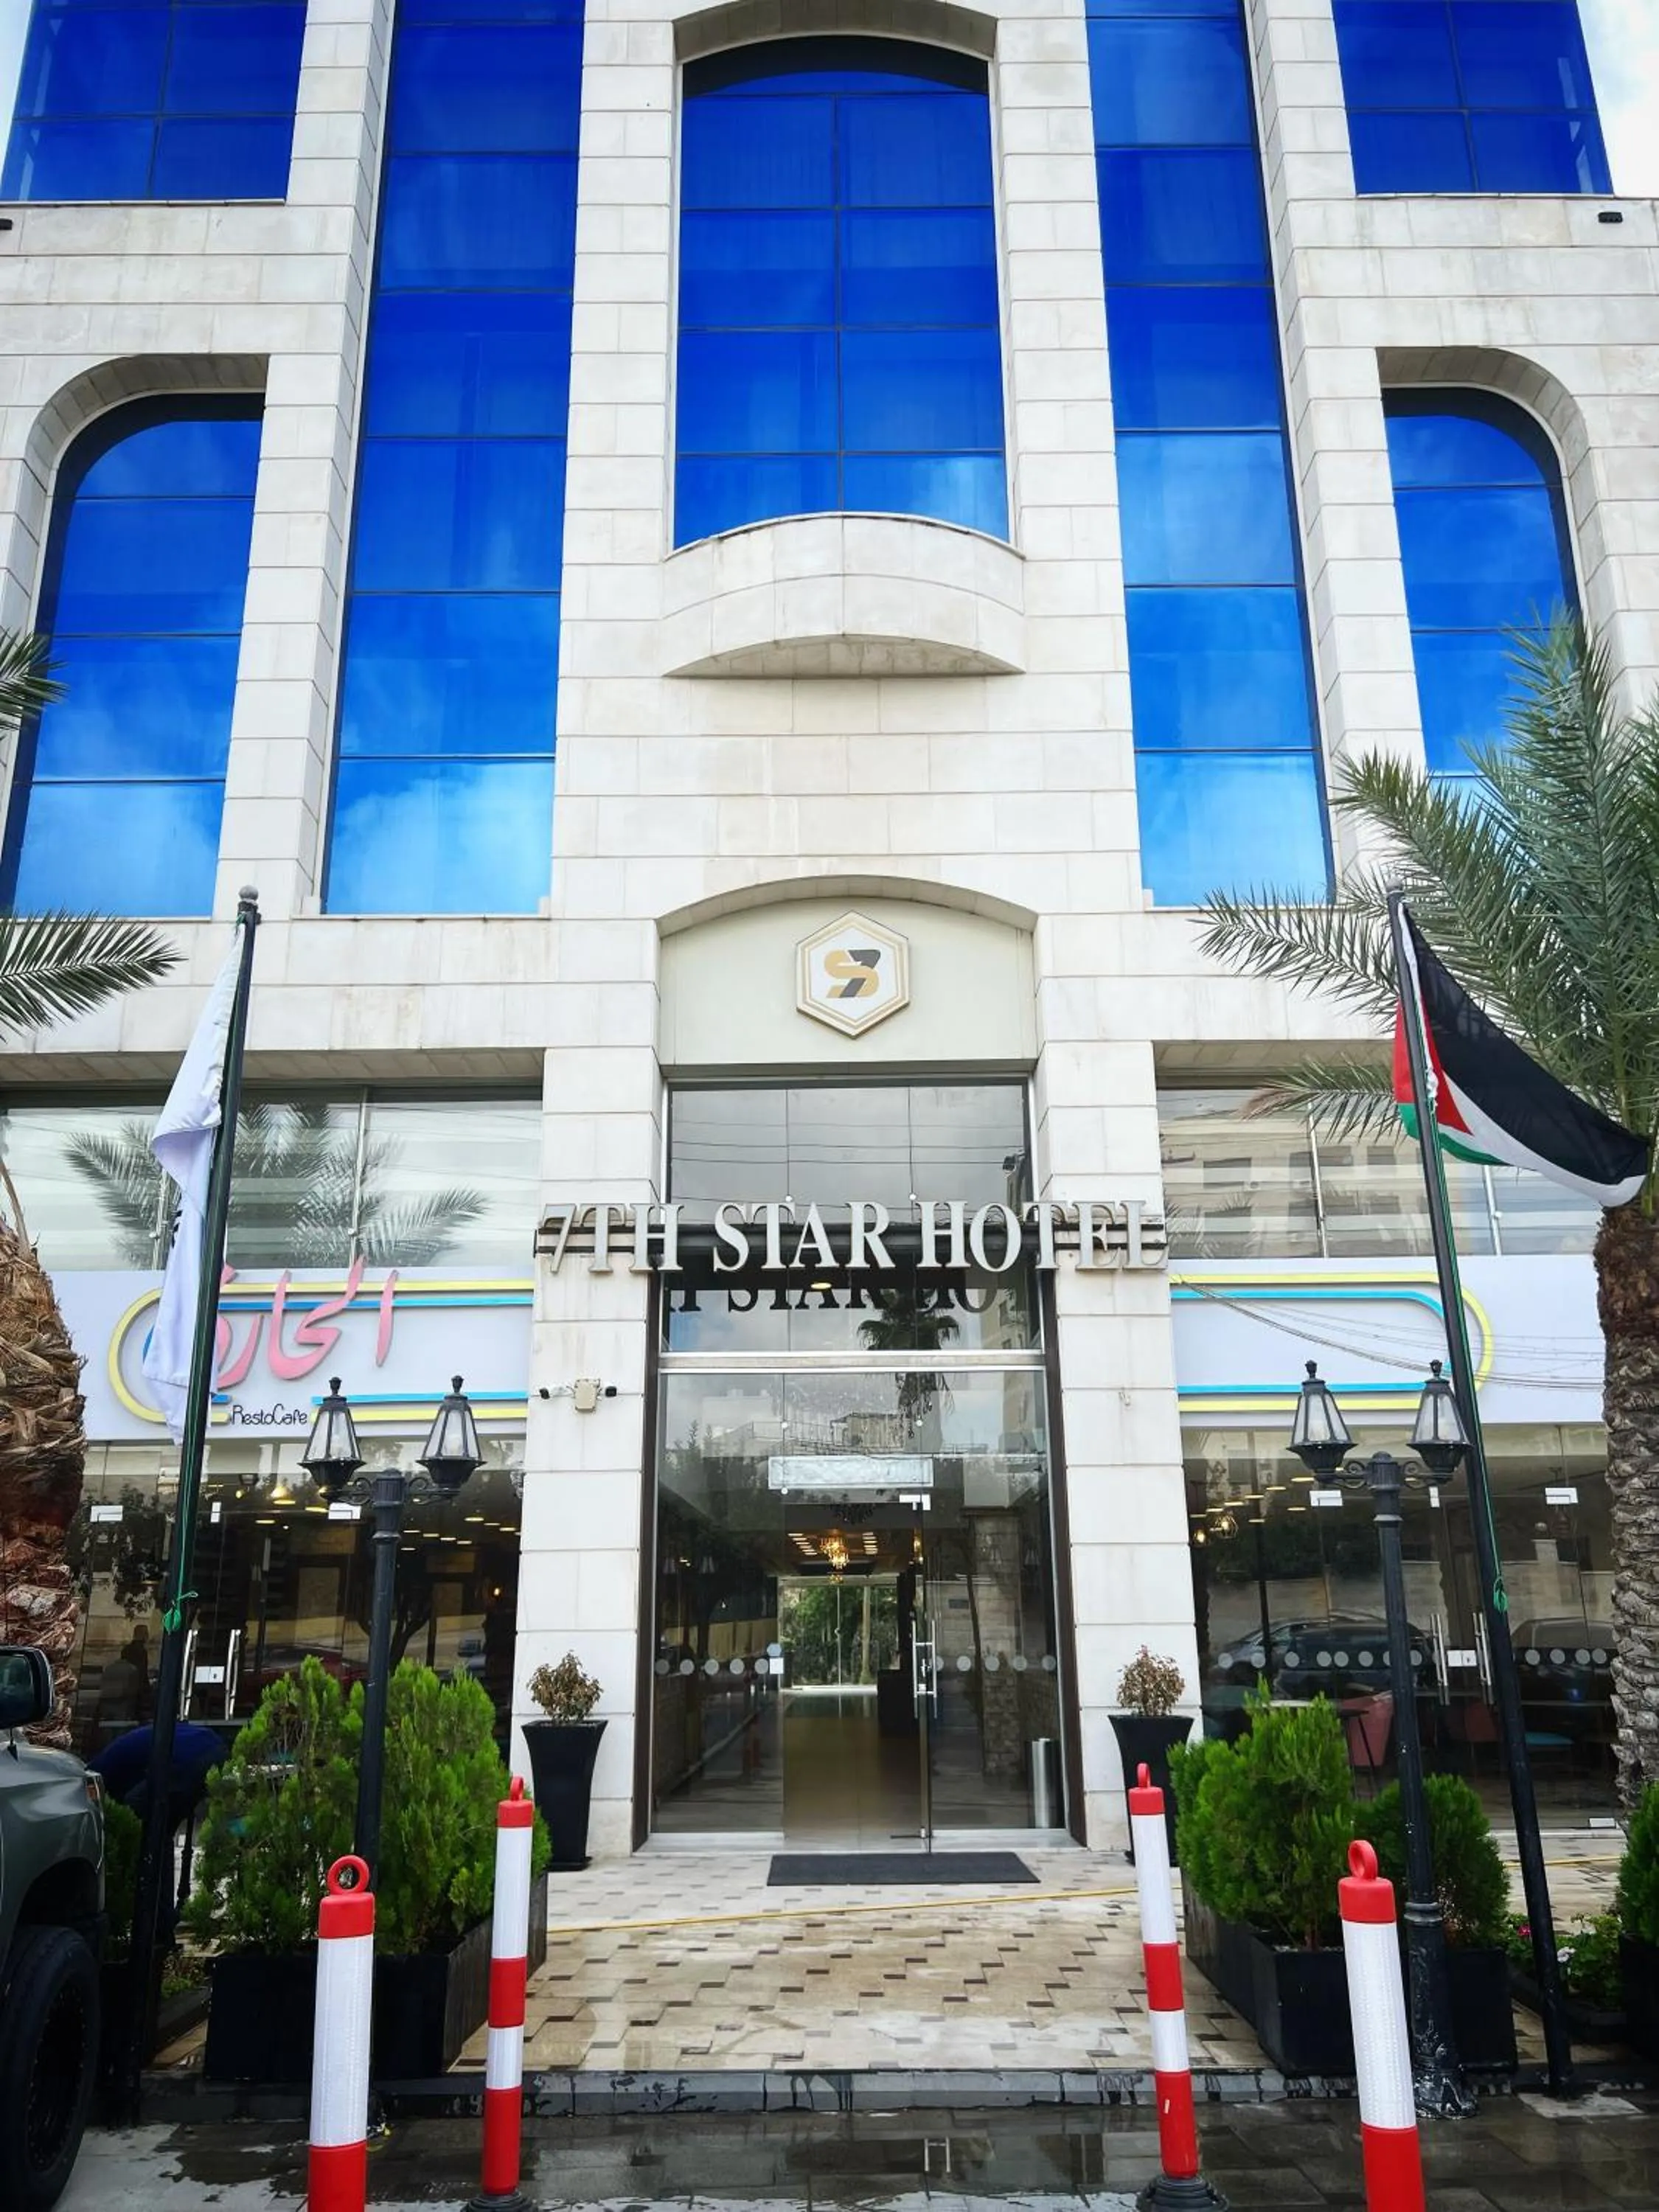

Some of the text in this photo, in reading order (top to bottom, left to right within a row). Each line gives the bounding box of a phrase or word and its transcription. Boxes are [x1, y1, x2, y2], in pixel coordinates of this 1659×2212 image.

[542, 1200, 1169, 1273] 7TH STAR HOTEL
[231, 1403, 307, 1425] RestoCafe
